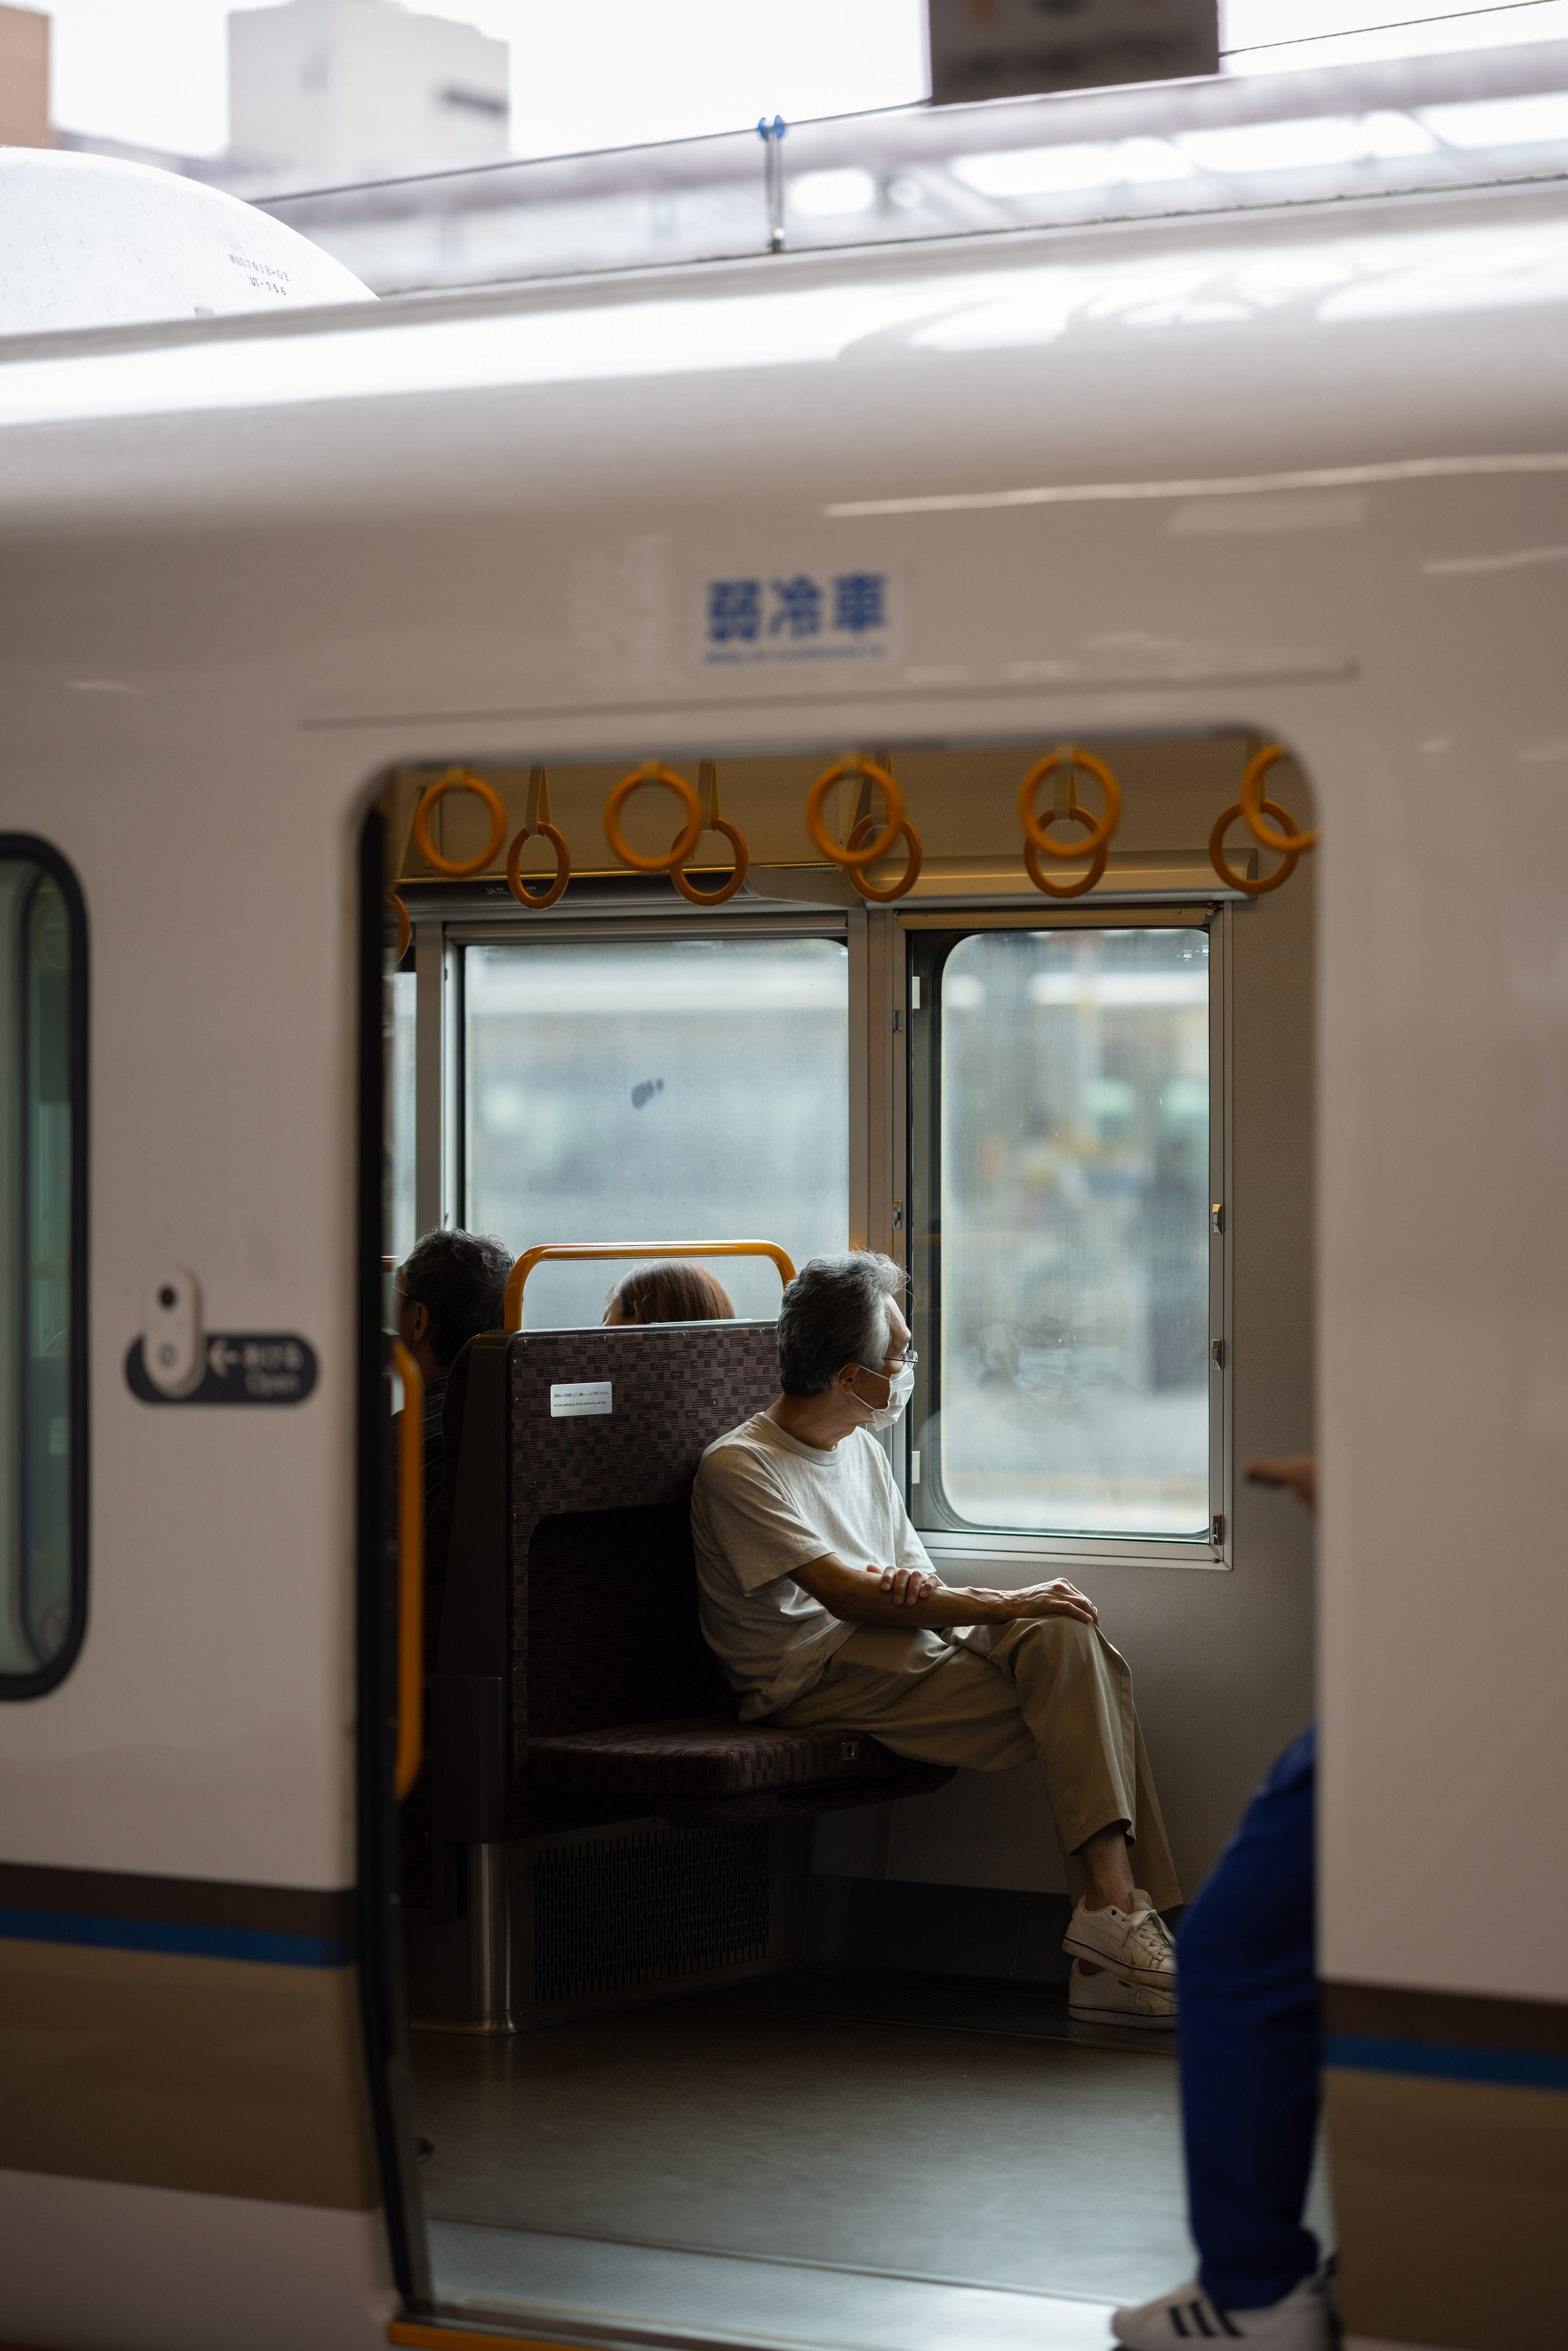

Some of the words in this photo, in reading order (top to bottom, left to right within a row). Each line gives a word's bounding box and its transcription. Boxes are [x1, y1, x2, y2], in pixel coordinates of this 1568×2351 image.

[249, 276, 287, 296] ST-756
[706, 570, 888, 641] 弱冷車
[1118, 1979, 1130, 1988] PUMA
